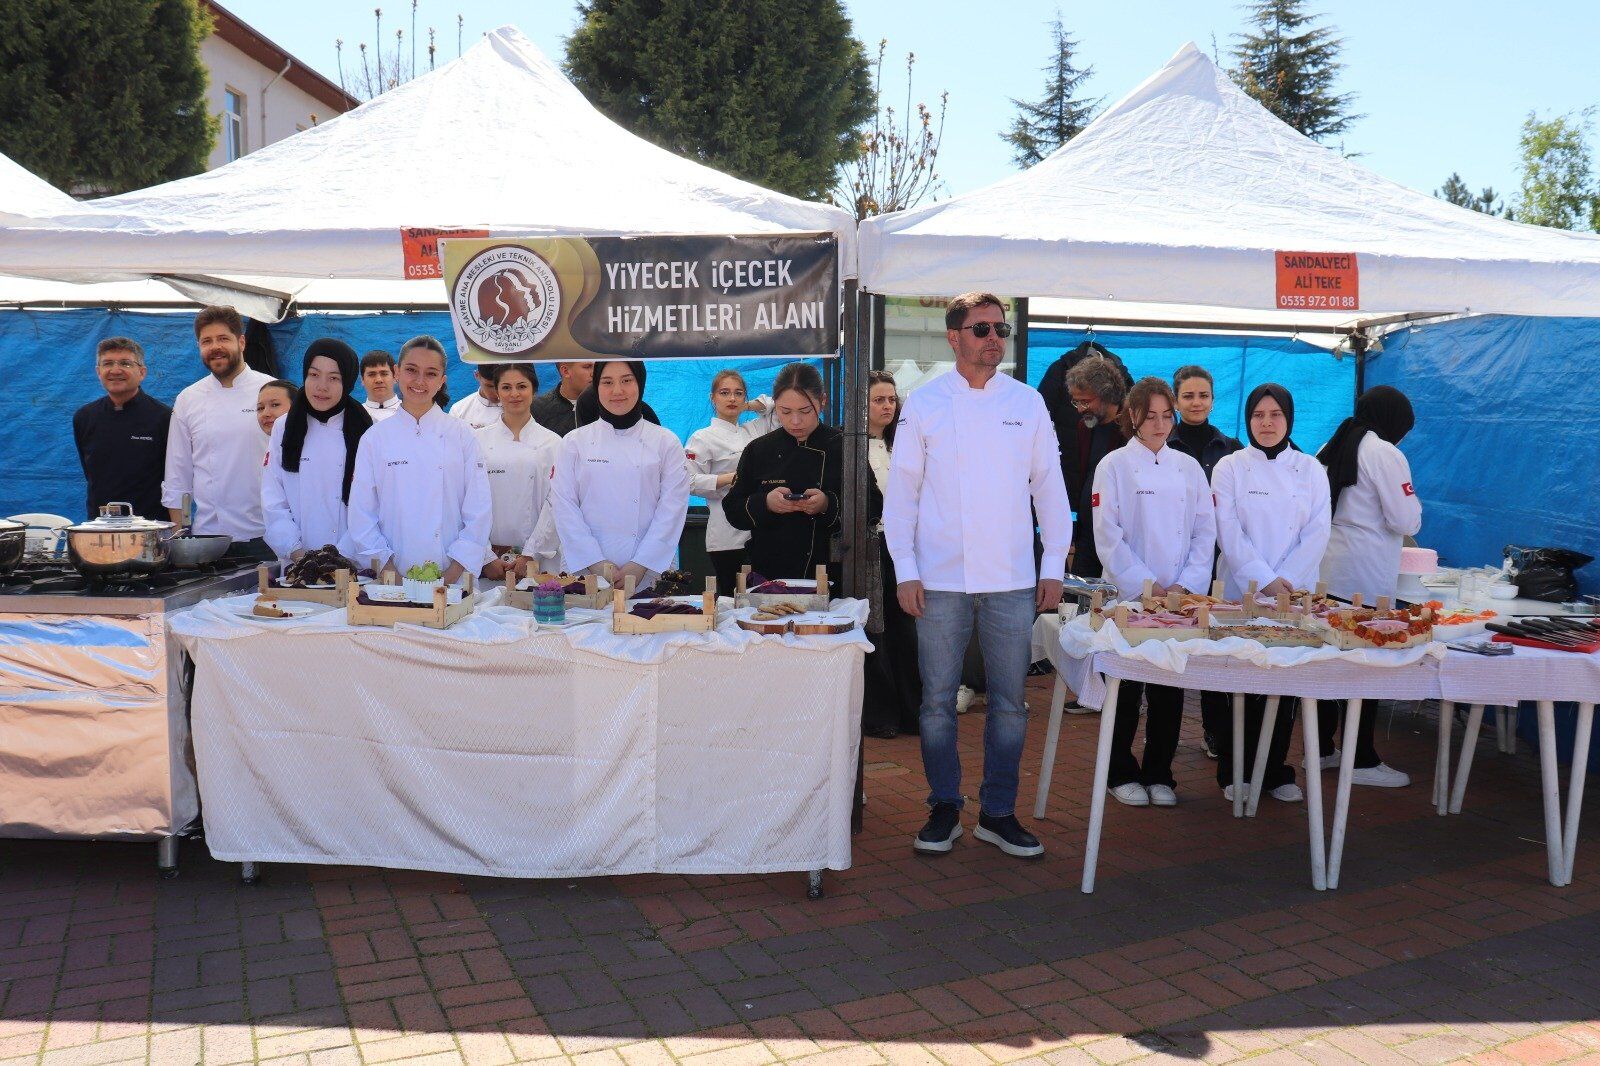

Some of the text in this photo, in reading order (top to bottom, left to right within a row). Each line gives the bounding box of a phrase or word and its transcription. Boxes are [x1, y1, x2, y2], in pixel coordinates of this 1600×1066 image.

[466, 254, 495, 280] MESLEKİ
[509, 252, 537, 266] TEKNİK
[1284, 255, 1351, 269] SANDALYECİ
[408, 264, 435, 276] 0535
[460, 281, 470, 298] ANA
[535, 266, 555, 302] ANADOLU
[1294, 274, 1342, 289] ALİ TEKE
[1280, 295, 1305, 306] 0535
[1308, 296, 1327, 306] 972
[460, 299, 472, 327] HAYME
[753, 301, 825, 330] ALANI
